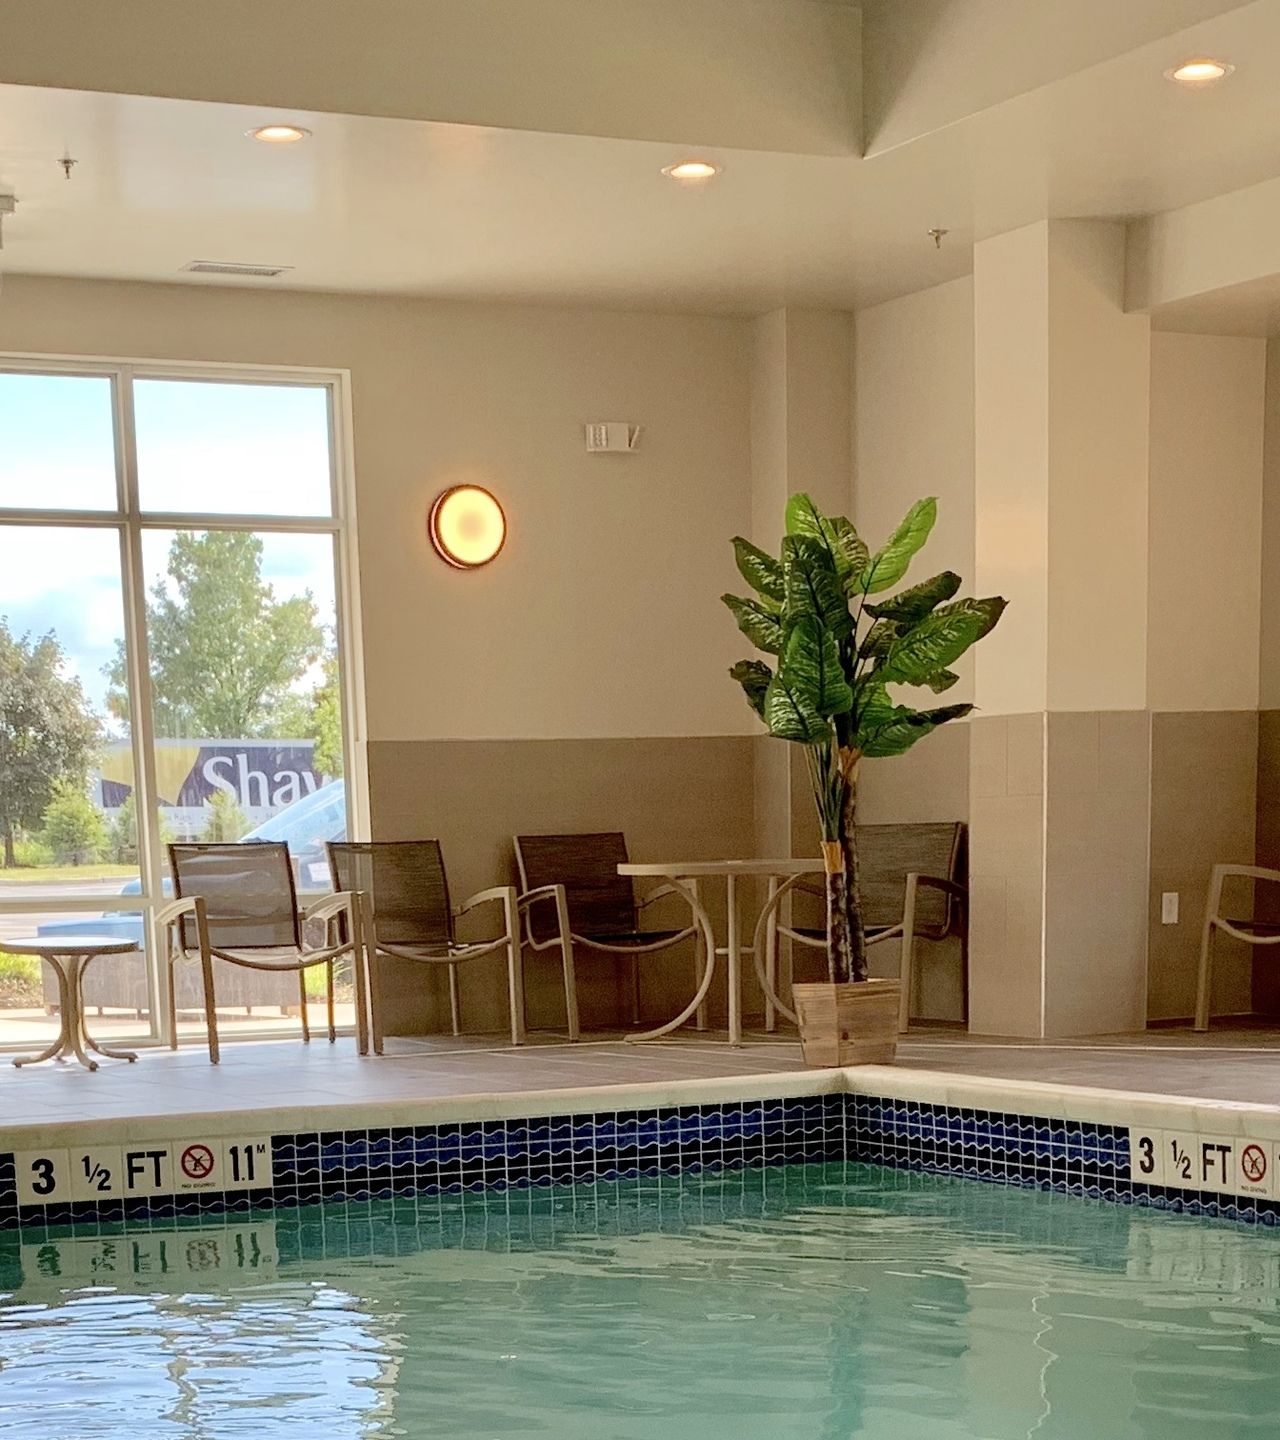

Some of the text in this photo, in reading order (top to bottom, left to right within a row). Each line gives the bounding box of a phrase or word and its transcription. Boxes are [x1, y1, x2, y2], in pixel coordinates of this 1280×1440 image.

[31, 1158, 56, 1195] 3
[126, 1150, 167, 1189] FT
[1139, 1136, 1155, 1174] 3
[1202, 1142, 1232, 1184] FT
